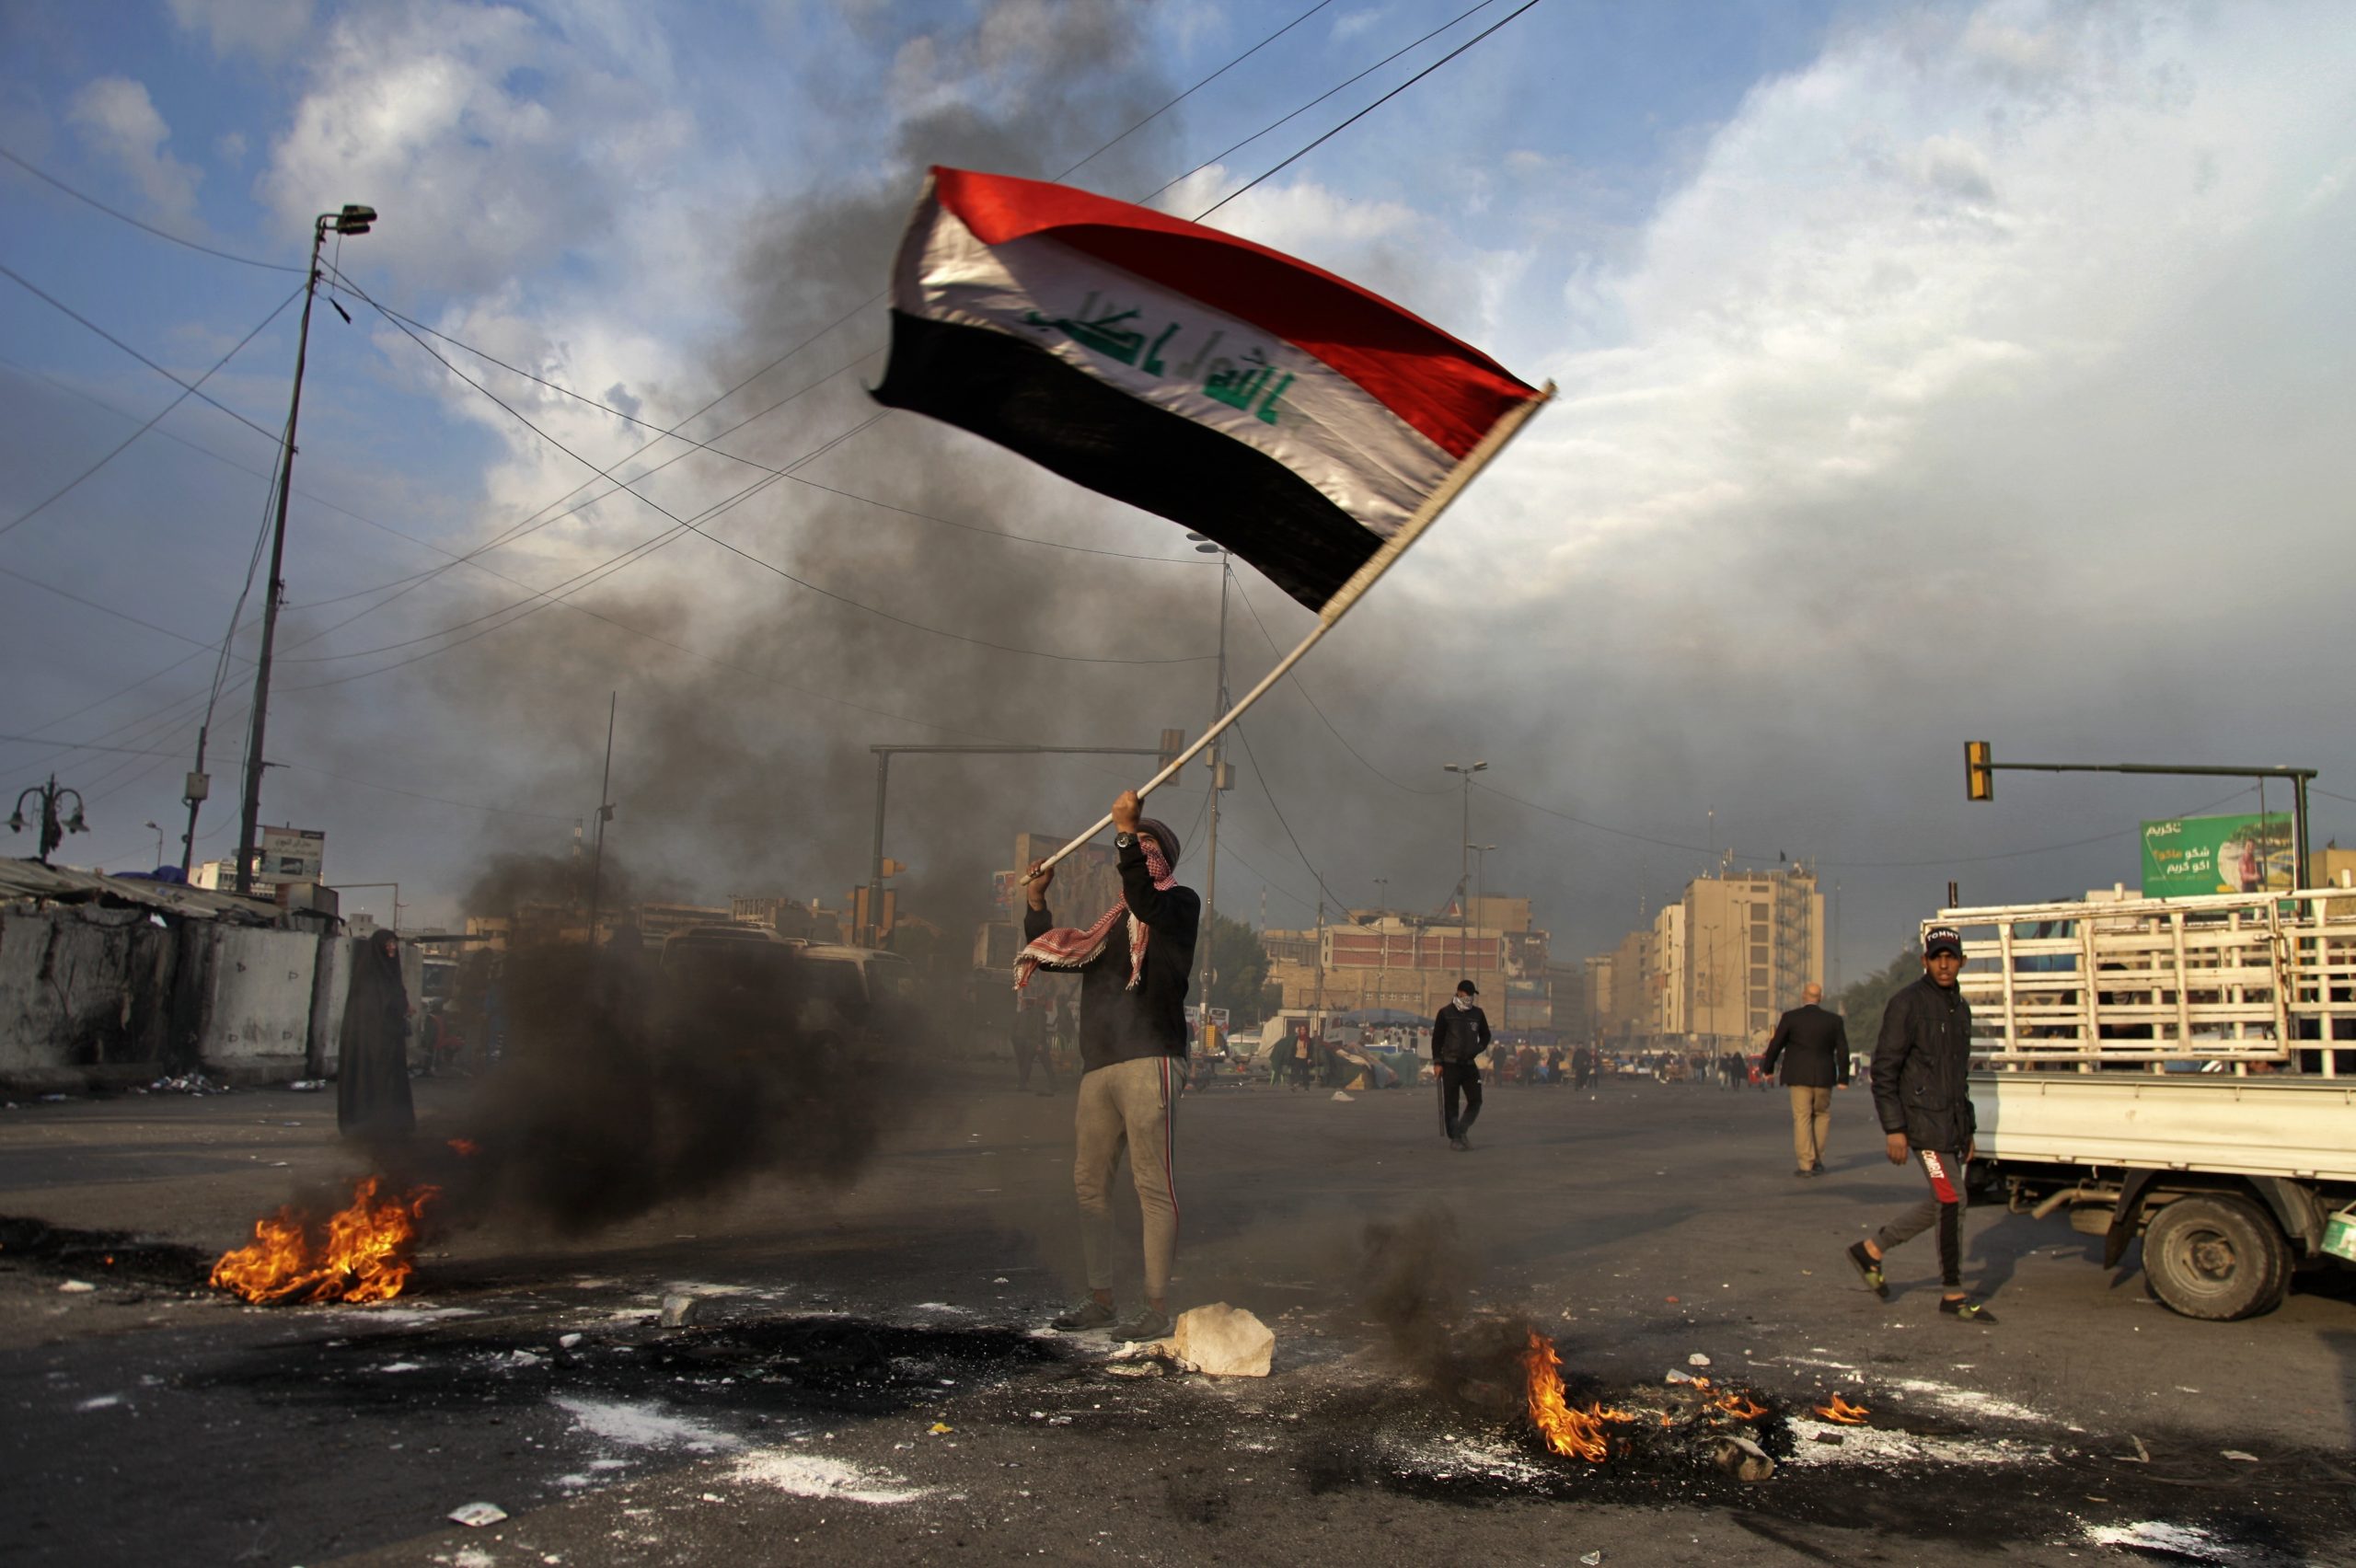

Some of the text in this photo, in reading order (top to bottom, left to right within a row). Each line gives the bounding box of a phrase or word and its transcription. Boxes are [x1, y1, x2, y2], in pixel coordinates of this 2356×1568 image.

[2185, 847, 2210, 860] شكو
[2166, 860, 2190, 874] كريم
[1927, 930, 1958, 941] TOMMY
